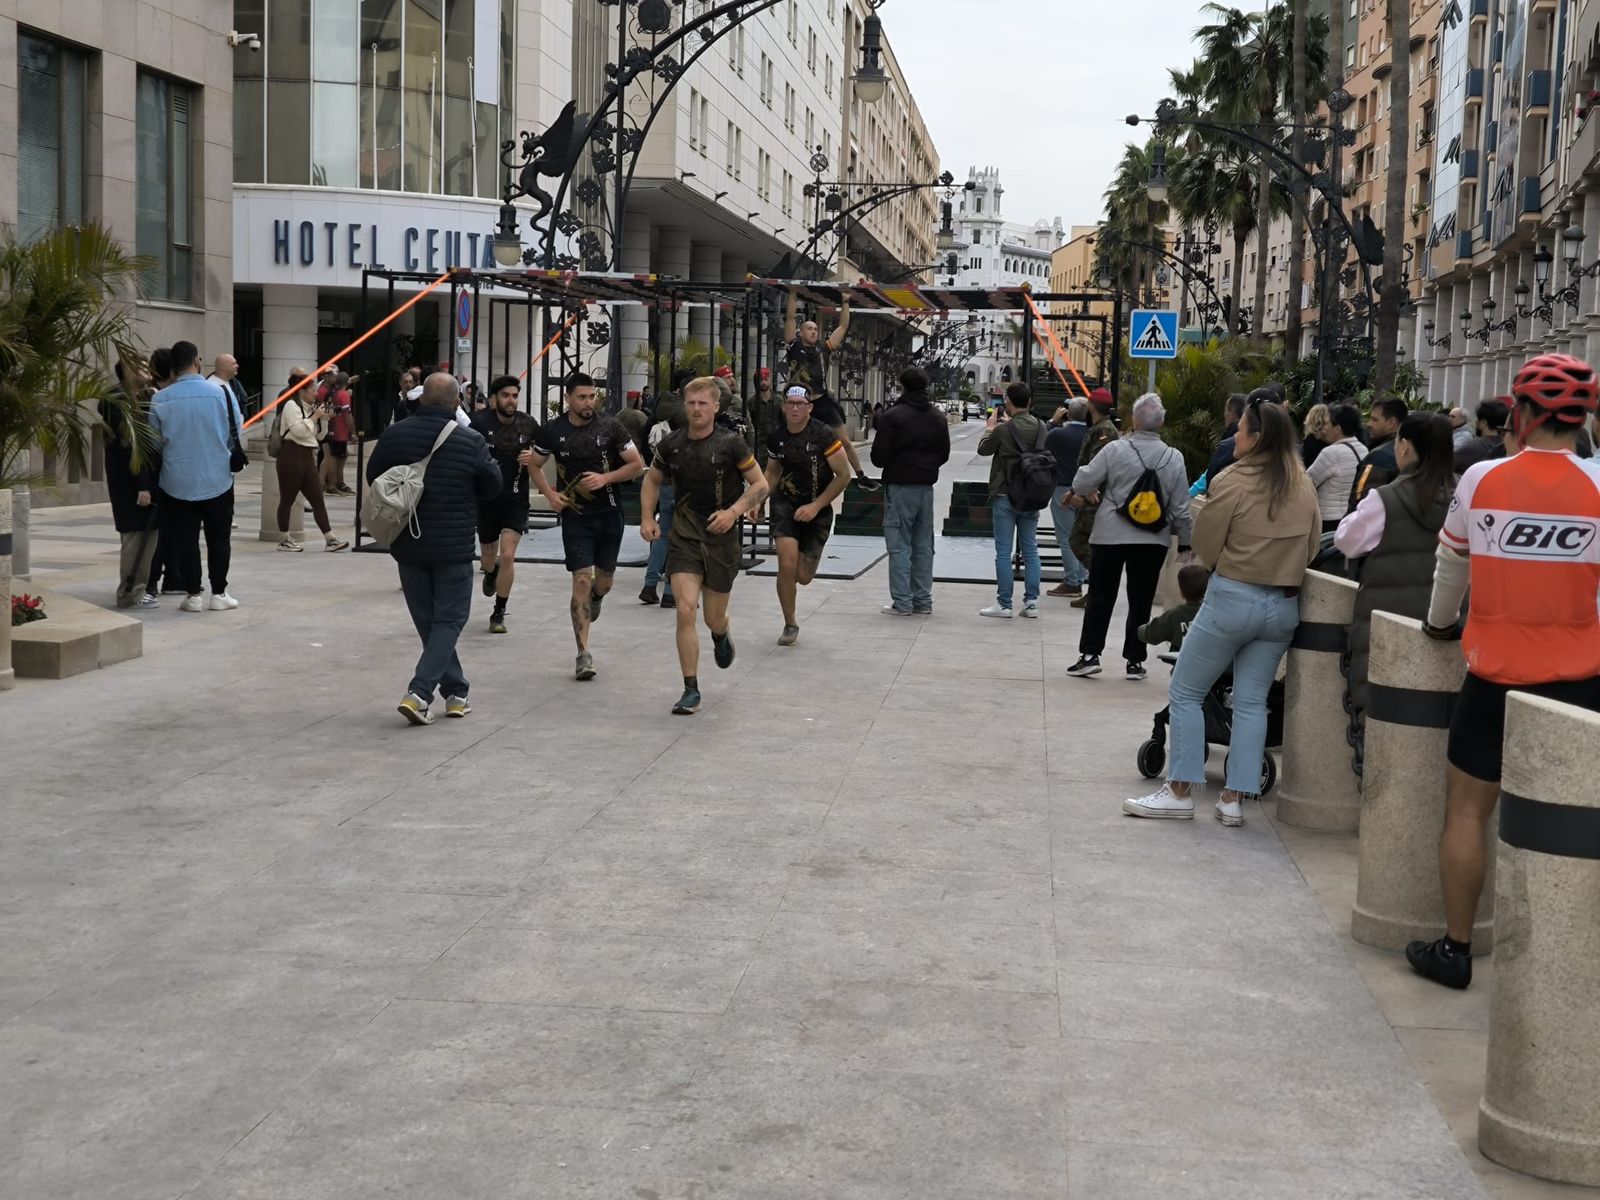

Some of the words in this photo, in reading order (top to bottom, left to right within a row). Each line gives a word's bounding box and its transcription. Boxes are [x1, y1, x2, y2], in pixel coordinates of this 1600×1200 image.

[274, 219, 385, 270] HOTEL
[404, 227, 497, 272] CEUTA
[1505, 523, 1592, 550] BiC
